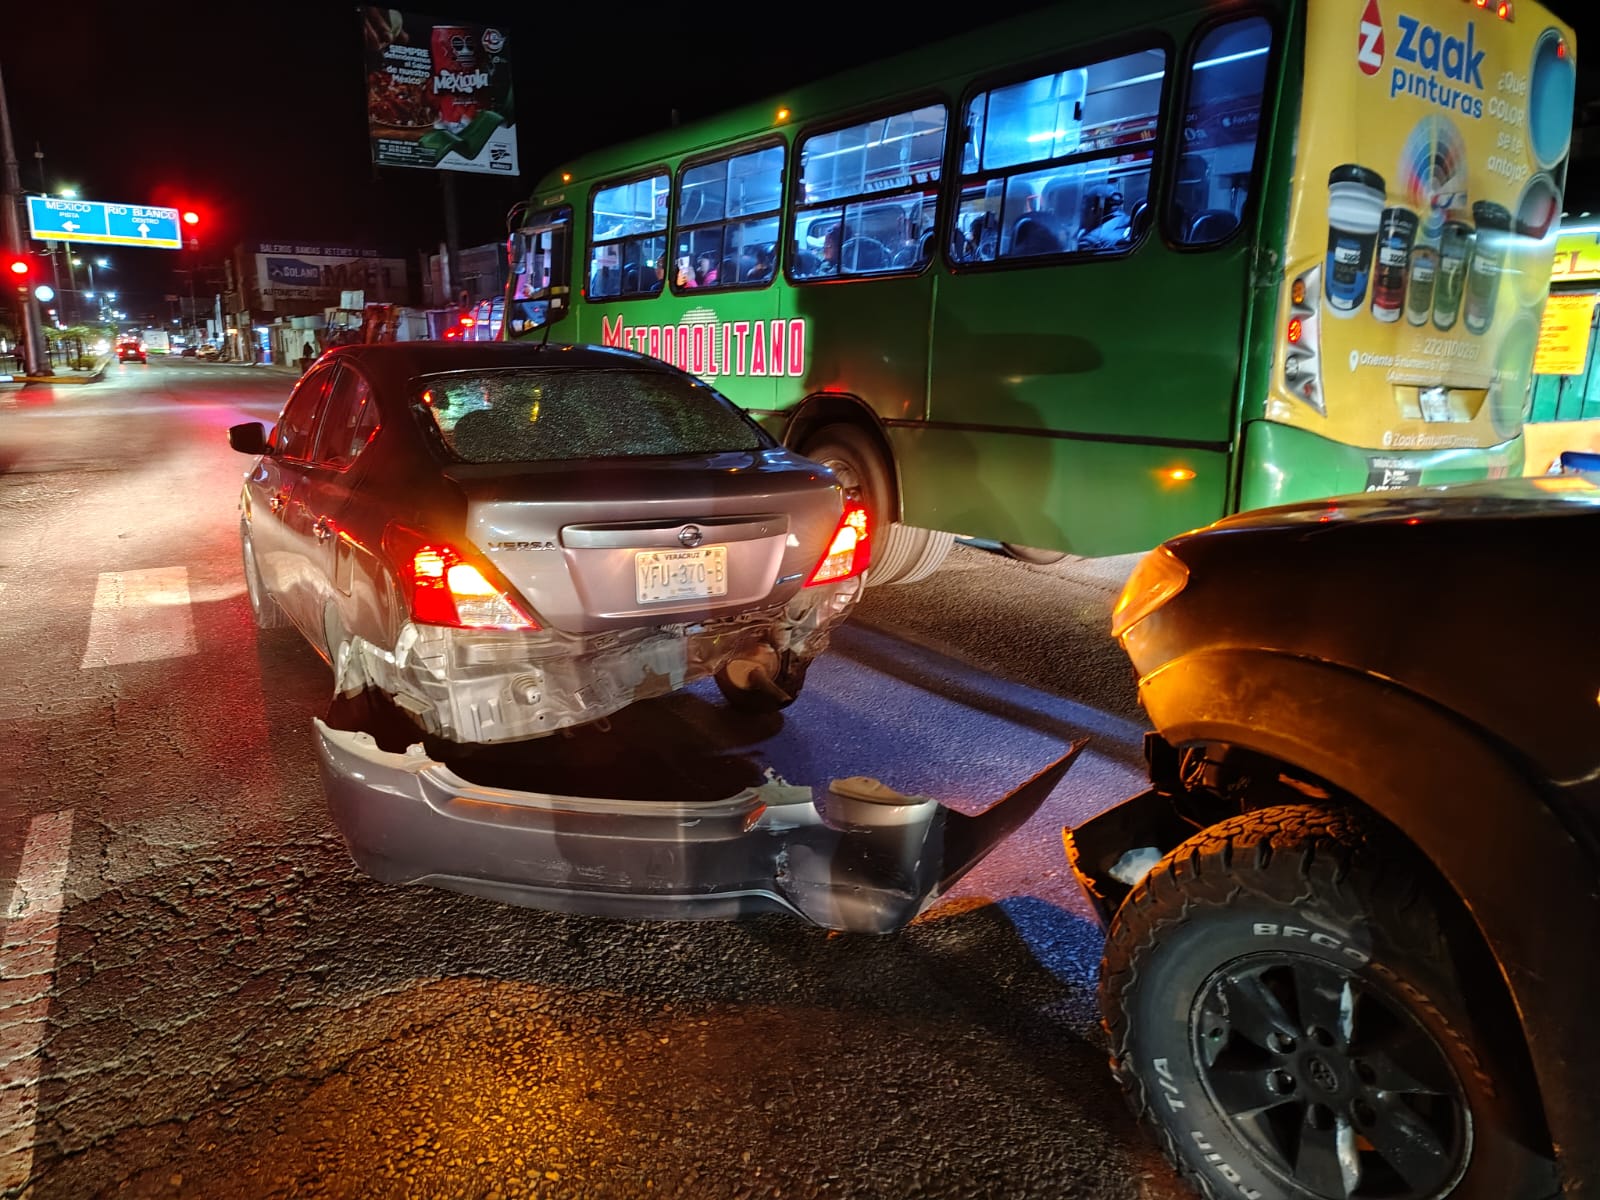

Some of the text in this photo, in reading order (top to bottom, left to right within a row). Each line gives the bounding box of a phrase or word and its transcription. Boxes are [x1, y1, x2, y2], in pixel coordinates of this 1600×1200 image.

[1394, 14, 1486, 90] zaak
[386, 65, 431, 79] de nuestro
[1390, 67, 1485, 120] pinturas
[1487, 155, 1528, 186] antoja?
[45, 201, 91, 213] MEXICO
[108, 206, 177, 220] RIO BLANCO
[131, 217, 159, 225] CENTRO
[283, 266, 319, 278] SOLANO
[488, 541, 556, 552] VERSA
[665, 552, 700, 561] VERACRUZ
[641, 562, 724, 590] YFU-370-B
